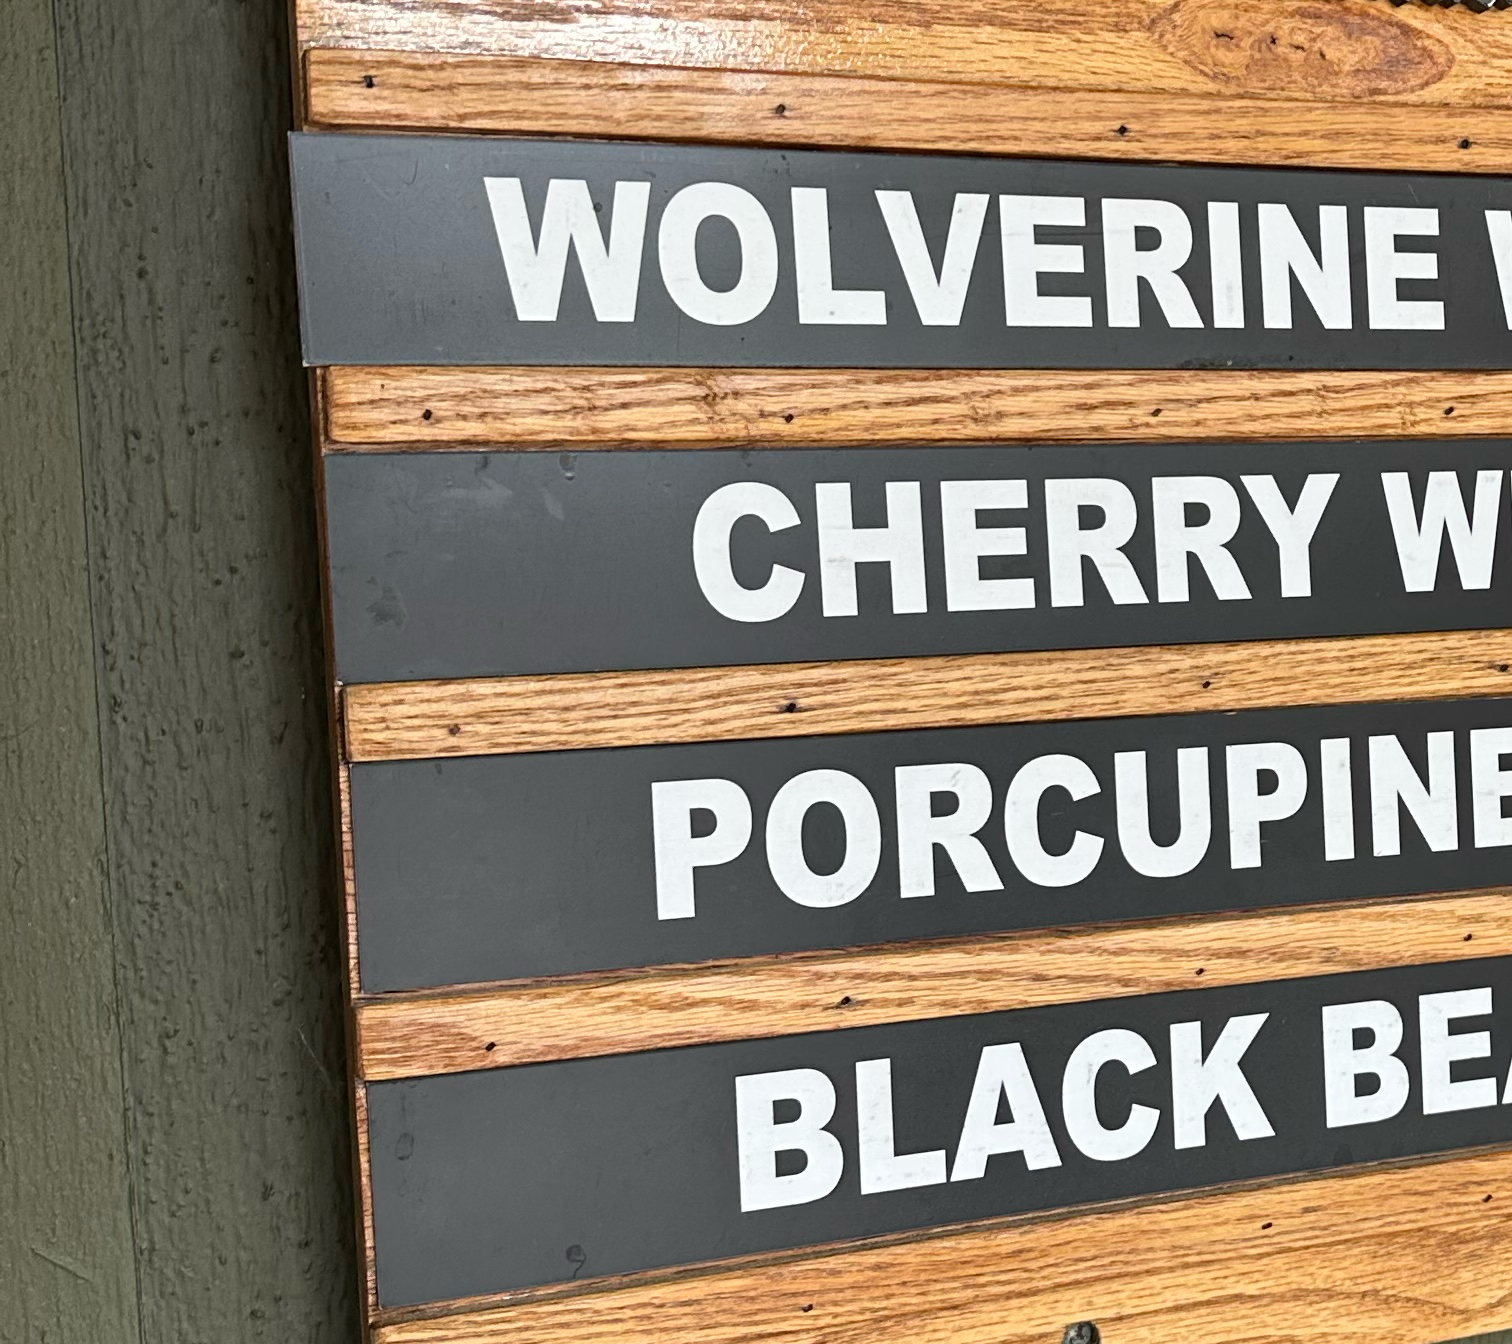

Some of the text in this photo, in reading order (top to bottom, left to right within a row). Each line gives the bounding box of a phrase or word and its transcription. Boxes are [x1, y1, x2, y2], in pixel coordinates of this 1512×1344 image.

[483, 176, 1446, 331] WOLVERINE
[692, 473, 1341, 623] CHERRY
[734, 1012, 1276, 1213] BLACK
